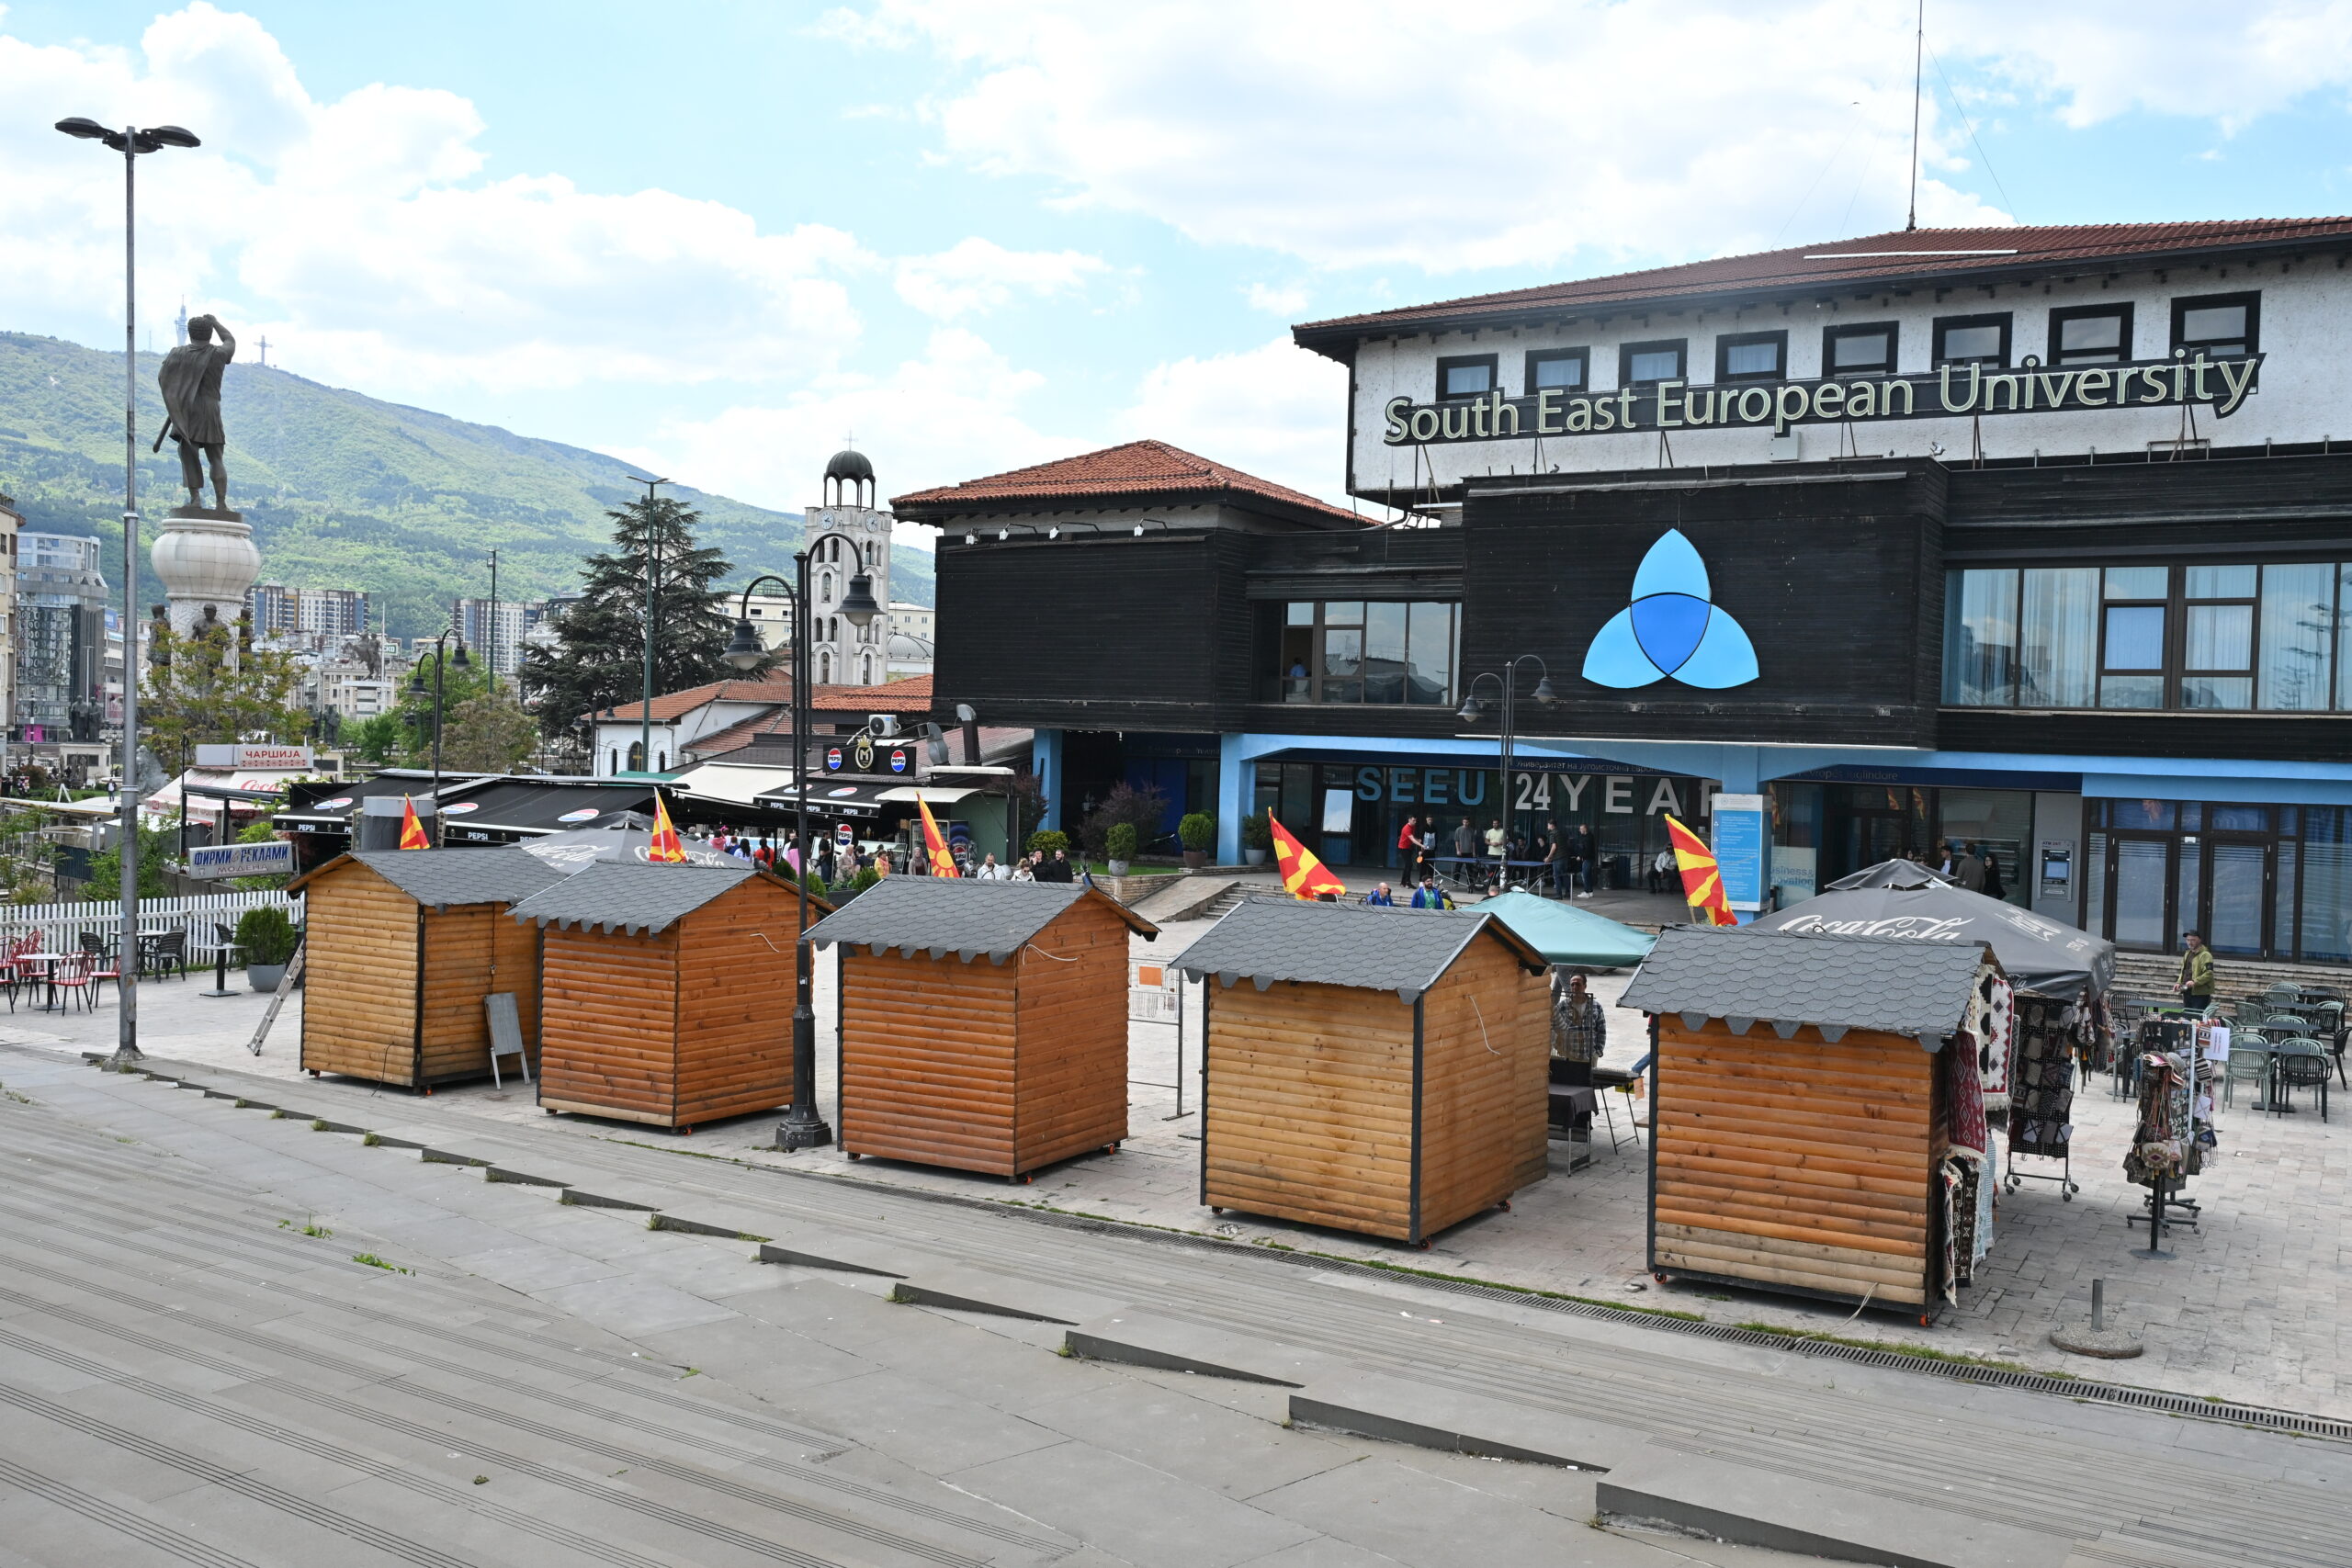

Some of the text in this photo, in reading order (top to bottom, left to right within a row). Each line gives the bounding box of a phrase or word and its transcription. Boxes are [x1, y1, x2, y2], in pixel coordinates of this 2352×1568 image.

[1385, 349, 2256, 443] South East European University
[245, 750, 300, 759] ЧАРШИЈА
[1357, 767, 1485, 806] SEEU
[1515, 773, 1552, 811] 24
[298, 823, 316, 831] PEPSI
[468, 831, 489, 840] PEPSI
[194, 850, 232, 866] ФИРМИ
[241, 846, 288, 863] РЕКЛАМИ
[217, 864, 269, 874] МОДЕНА
